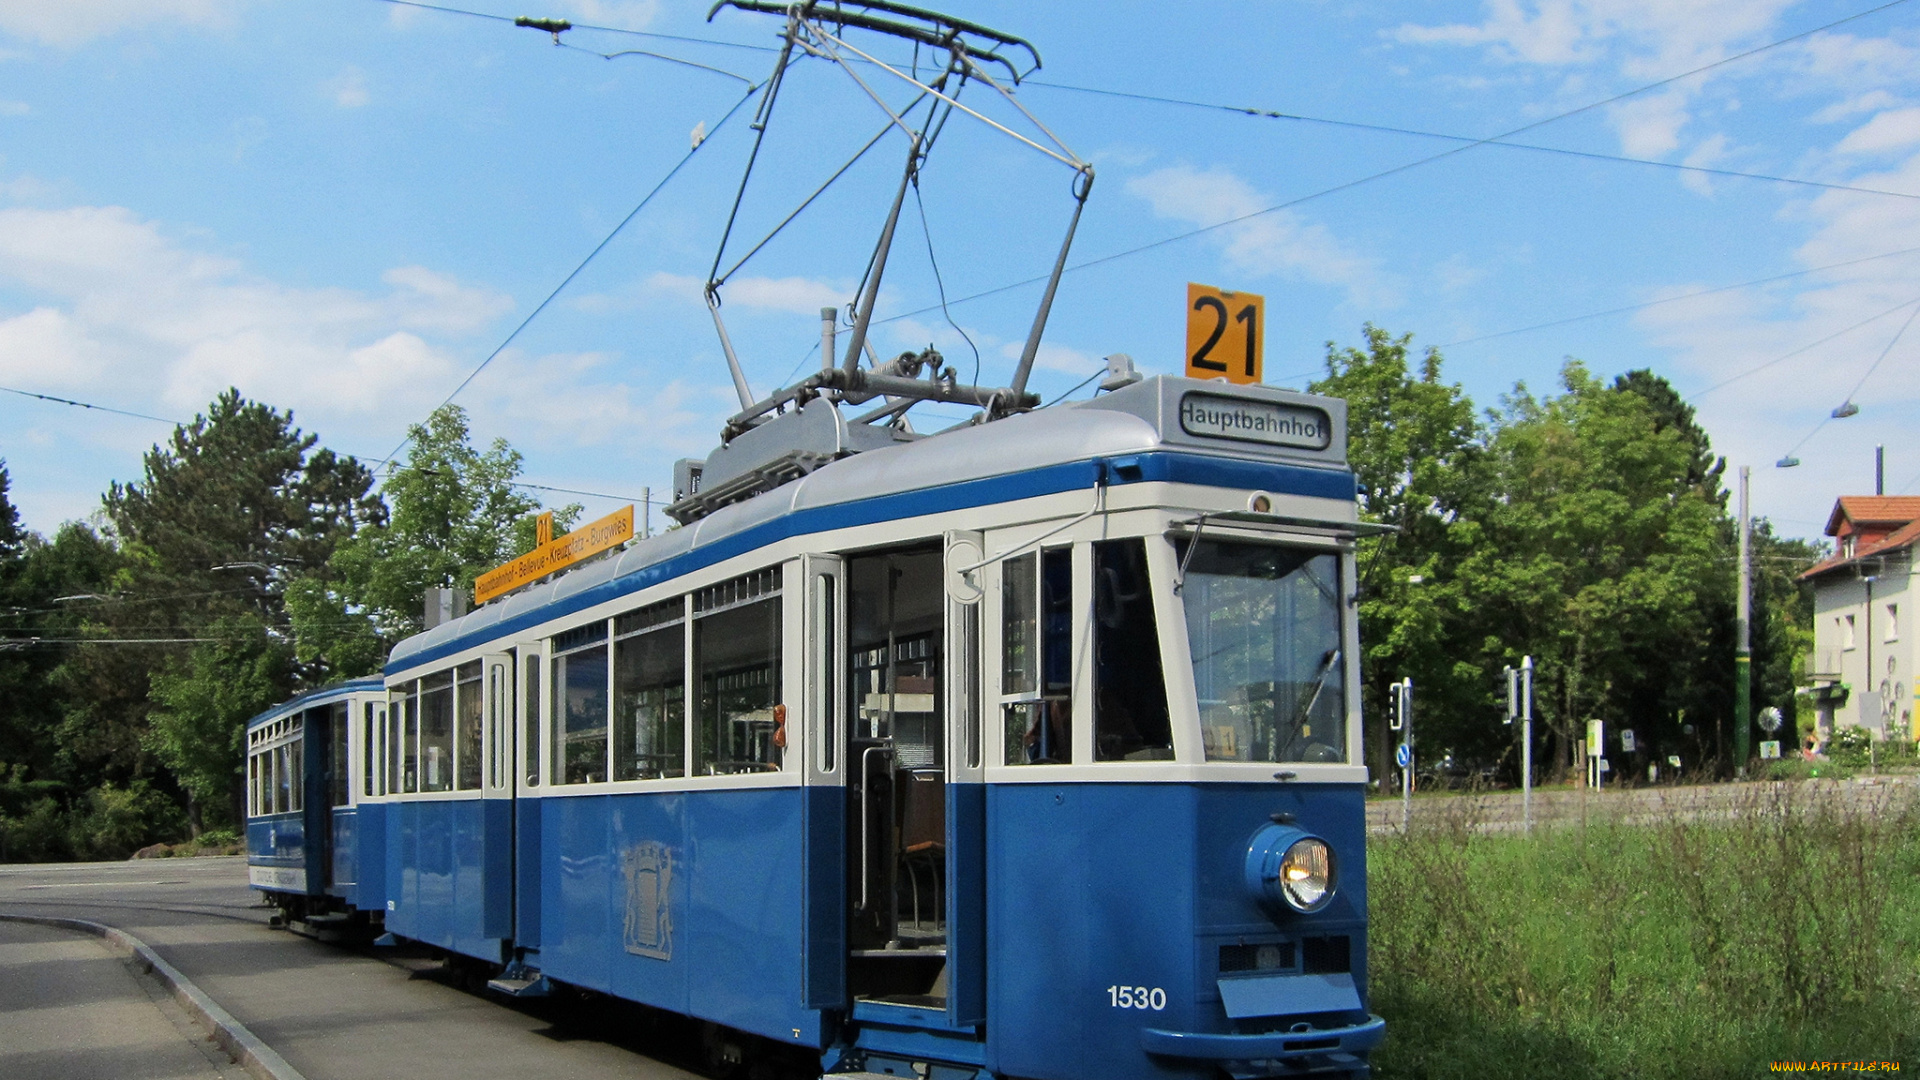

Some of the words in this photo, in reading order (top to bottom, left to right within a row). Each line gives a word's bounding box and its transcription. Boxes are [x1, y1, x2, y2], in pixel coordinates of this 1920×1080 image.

[1191, 295, 1256, 377] 21
[1182, 402, 1323, 439] Hauptbahnhof
[538, 517, 548, 546] 21
[477, 564, 514, 595] Hauptbahnhof
[519, 556, 545, 578] Bellevue
[549, 537, 584, 564] Kreuzplatz
[591, 516, 627, 547] Burgwies
[1107, 985, 1167, 1011] 1530
